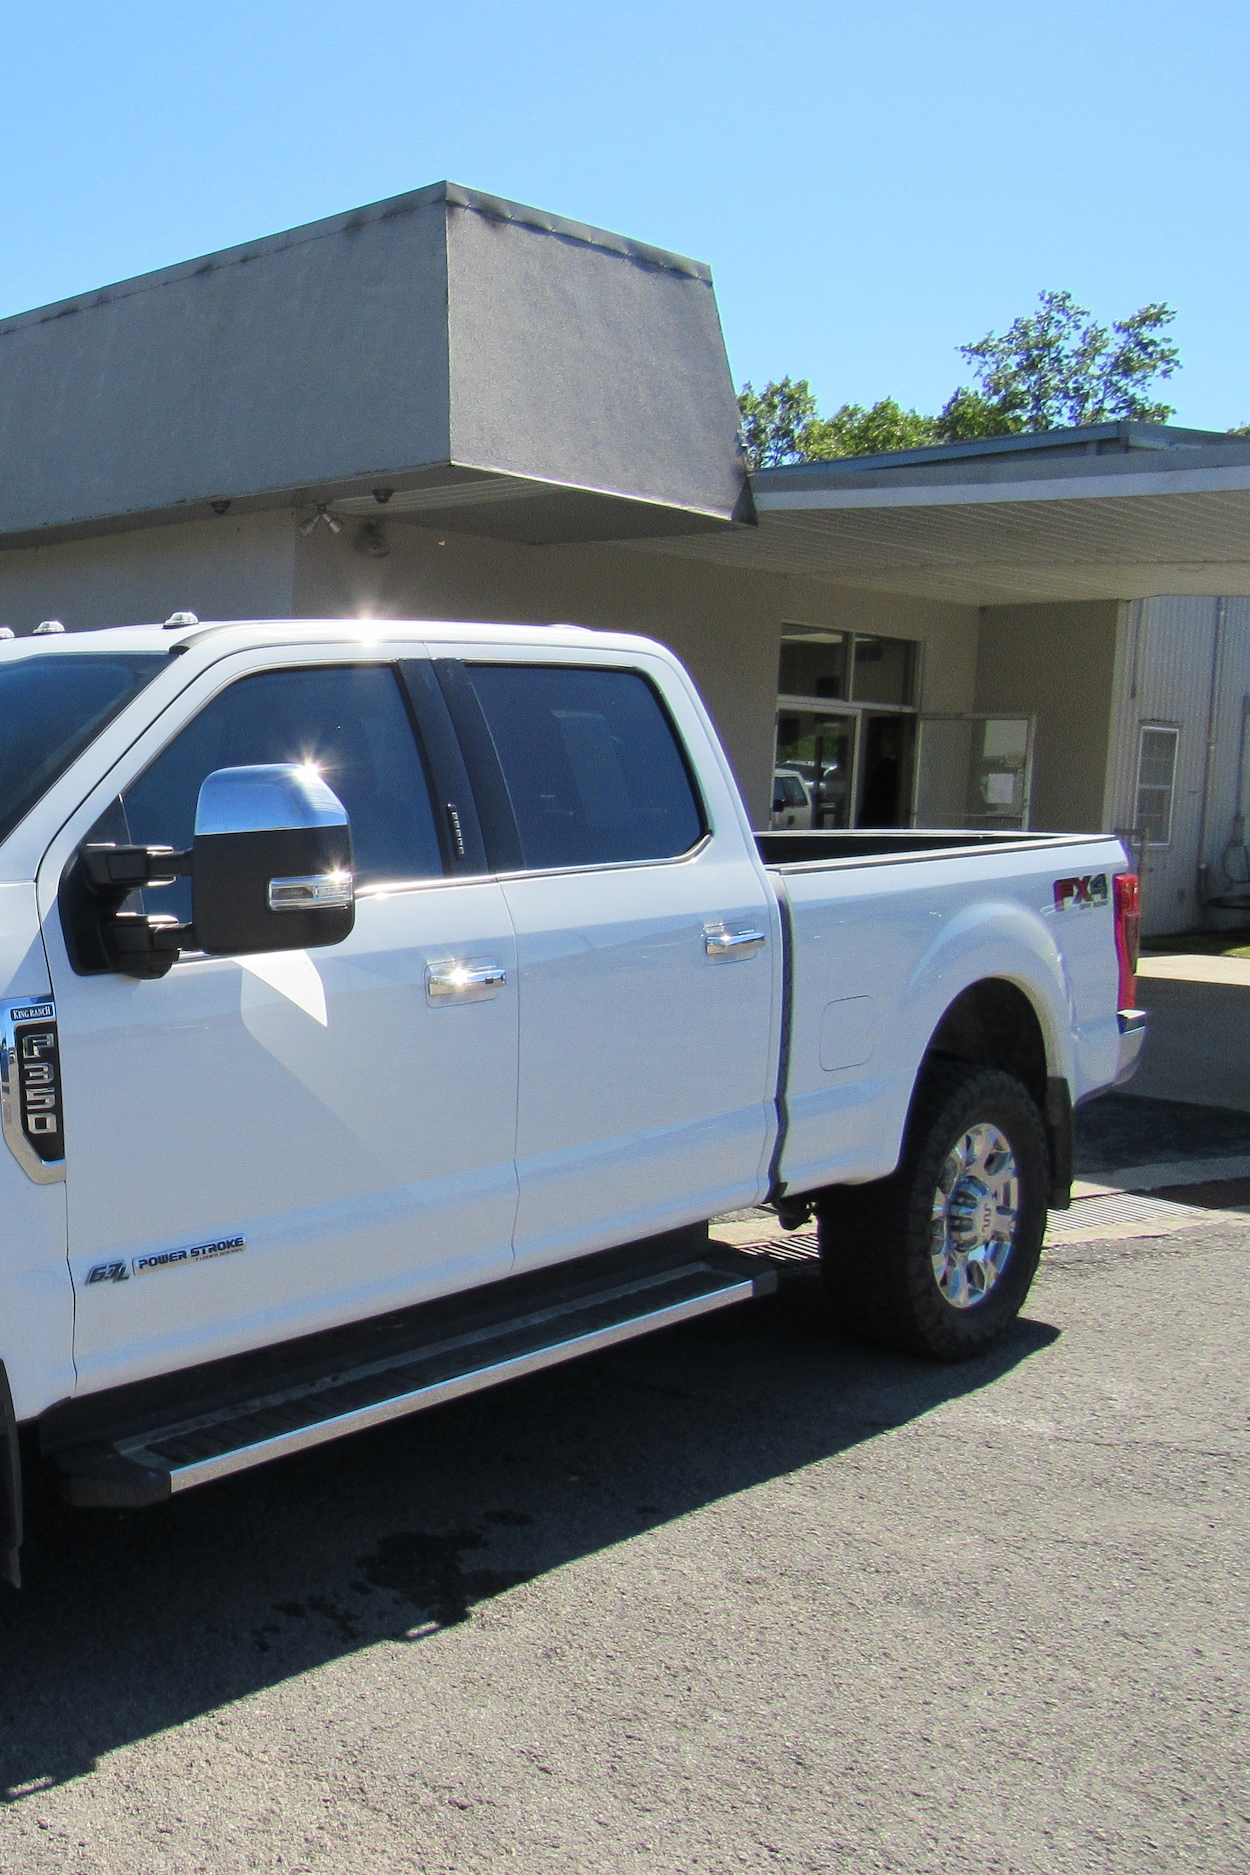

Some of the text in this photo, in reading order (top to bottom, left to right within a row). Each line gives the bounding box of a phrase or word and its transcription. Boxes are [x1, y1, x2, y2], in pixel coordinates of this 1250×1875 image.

[1053, 872, 1108, 912] FX4
[13, 1005, 51, 1020] KING RANCH
[22, 1033, 57, 1134] F350
[139, 1250, 187, 1269] POWER
[190, 1237, 244, 1257] STROKE
